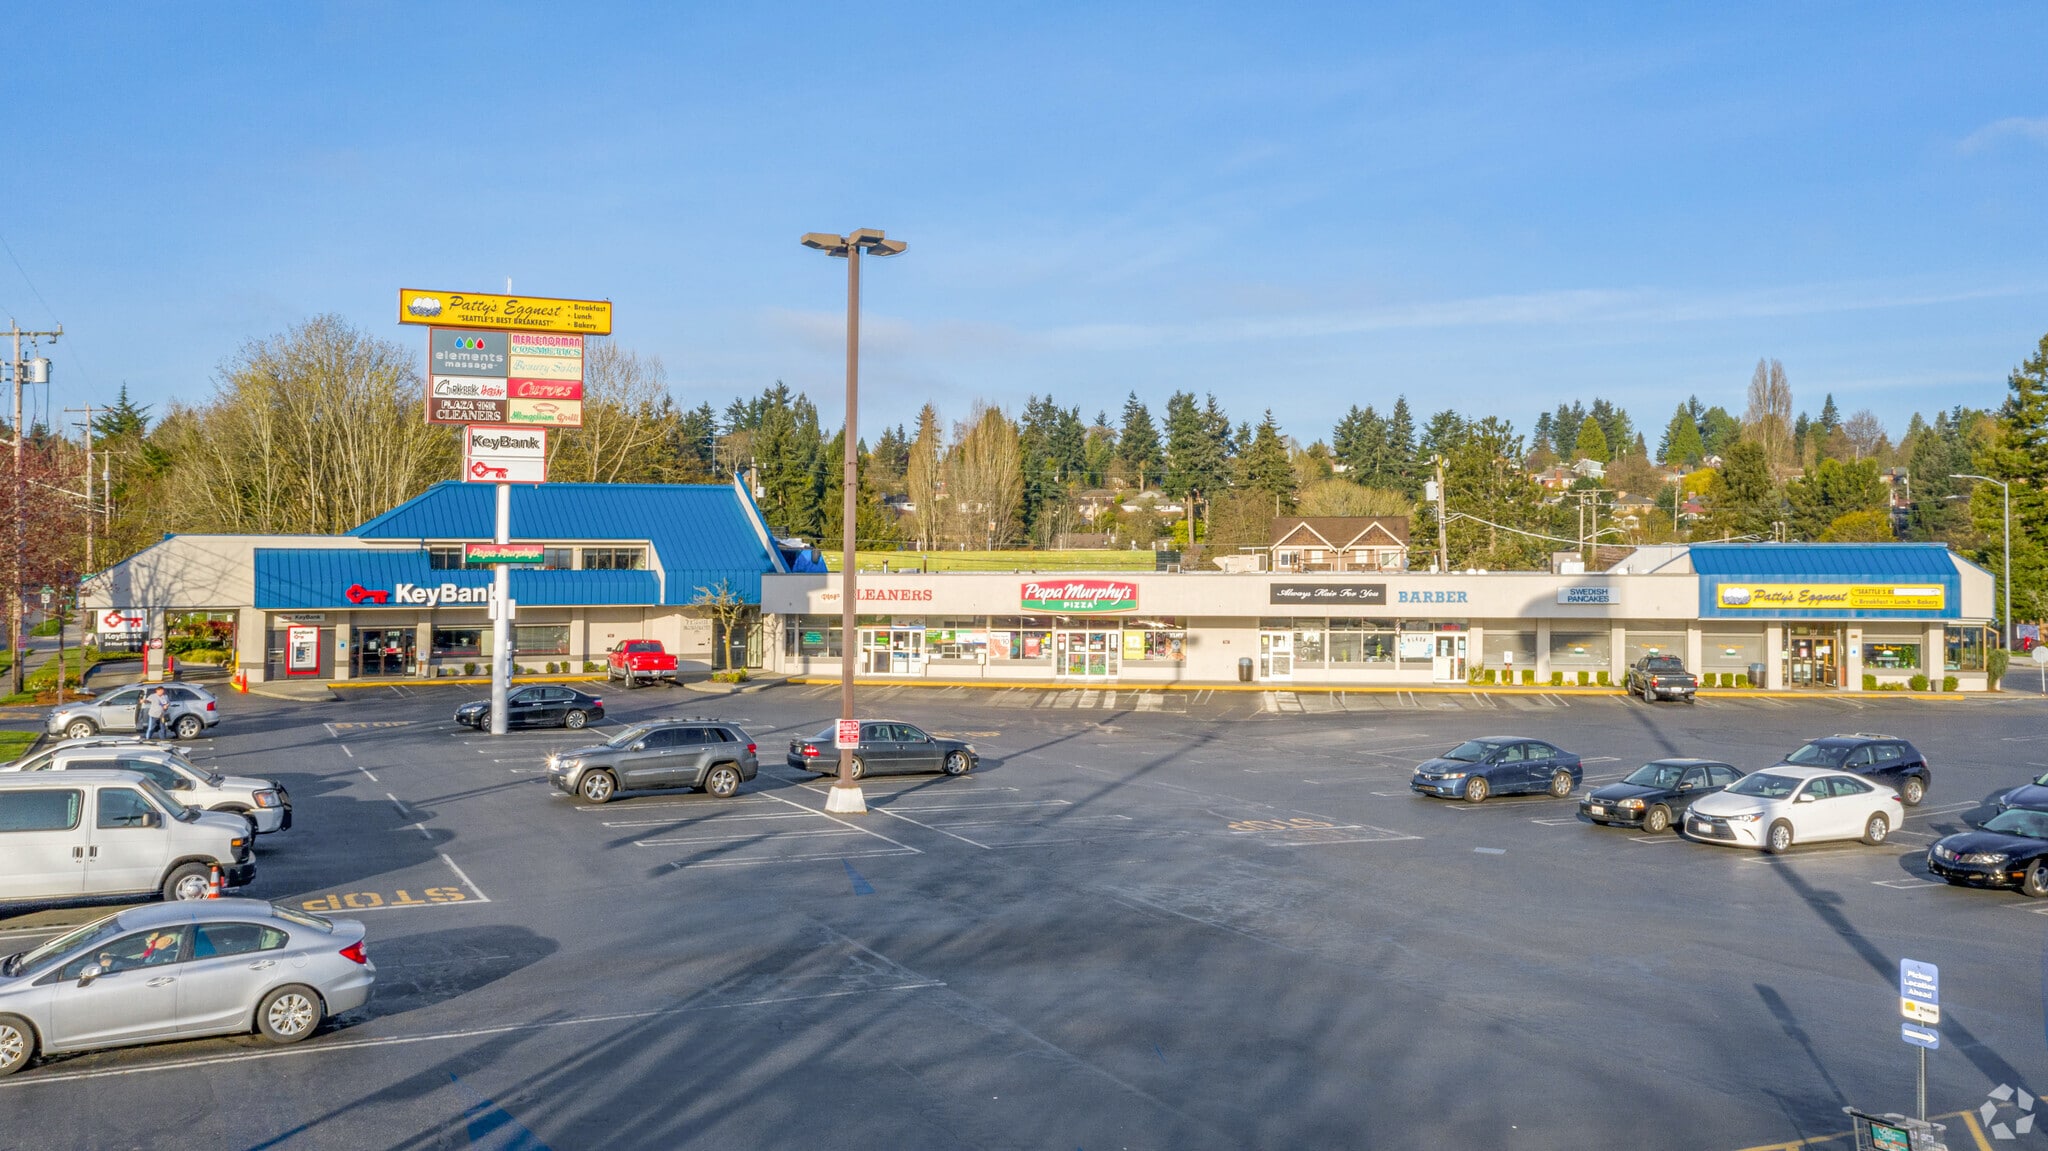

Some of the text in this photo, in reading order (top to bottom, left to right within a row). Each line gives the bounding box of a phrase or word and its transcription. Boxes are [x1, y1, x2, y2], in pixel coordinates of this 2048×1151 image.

[449, 295, 561, 319] Patty's Eggnest
[574, 304, 606, 312] Breakfast
[496, 316, 511, 324] BEST
[573, 321, 597, 330] Bakery
[435, 350, 504, 362] elements
[444, 361, 494, 370] massage
[518, 381, 572, 397] Curves
[441, 400, 475, 410] PLAZA
[436, 409, 501, 421] CLEANERS
[471, 434, 540, 451] KeyBank
[855, 588, 933, 601] LEANERS
[1025, 583, 1132, 606] Papa Murphy's
[1277, 588, 1379, 599] Always Hair For You
[1398, 591, 1468, 603] BARBER
[1570, 588, 1608, 596] SWEDISH
[1753, 588, 1848, 606] Patty's Eggnest
[1567, 595, 1609, 603] PANCAKES
[1063, 601, 1094, 609] PIZZA
[104, 633, 142, 641] KeyBank
[302, 886, 467, 911] STOP
[1904, 978, 1937, 991] Location
[1908, 988, 1933, 999] Ahead
